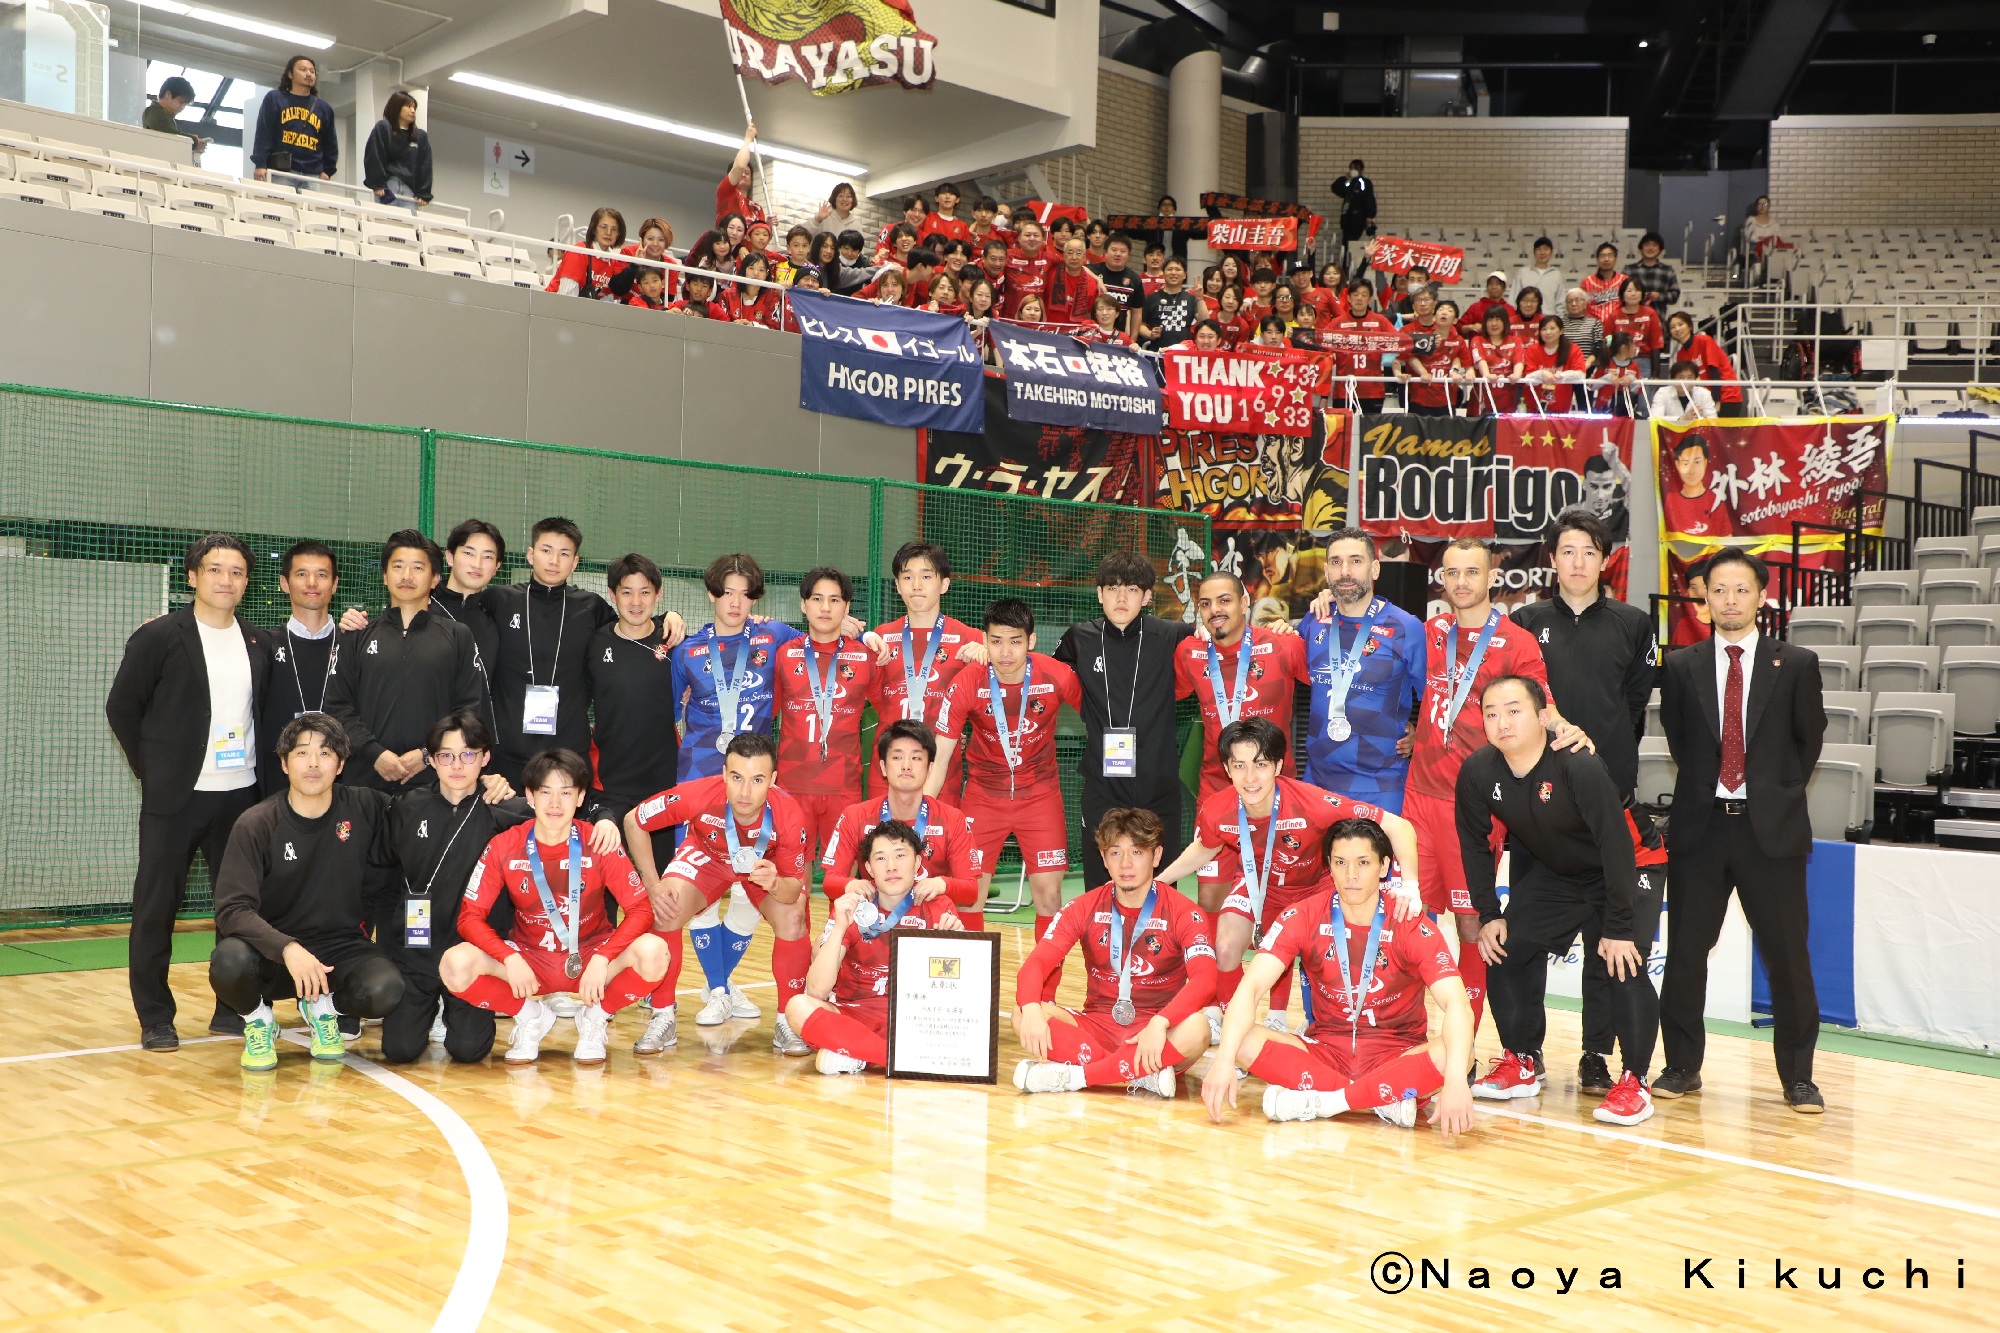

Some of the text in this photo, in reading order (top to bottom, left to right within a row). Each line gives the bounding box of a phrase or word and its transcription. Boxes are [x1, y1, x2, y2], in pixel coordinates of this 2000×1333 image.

[727, 26, 934, 88] URAYASU
[281, 106, 321, 132] CALIFONIA
[1210, 224, 1284, 246] 柴山圭吾
[1375, 243, 1462, 277] 茨木司朗
[800, 315, 975, 363] ピレス イゴール
[1001, 339, 1068, 376] 本石
[1352, 354, 1366, 369] 13
[1173, 355, 1266, 388] THANK
[828, 361, 962, 407] HIGOR PIRES
[1013, 381, 1156, 415] TAKEHIRO MOTOISHI
[1177, 391, 1232, 424] YOU
[1283, 406, 1311, 427] 33
[1364, 423, 1492, 458] Vamos
[1708, 451, 1792, 511] 外林
[1362, 454, 1584, 533] Rodrigo
[1740, 487, 1821, 527] sotobayashi
[1367, 604, 1378, 618] JFA
[743, 626, 751, 639] JFA
[1244, 632, 1252, 647] JFA
[921, 666, 929, 679] JFA
[1331, 657, 1339, 672] JFA
[1463, 666, 1475, 682] JFA
[732, 678, 740, 692] JFA
[1350, 683, 1375, 693] ervice
[1216, 691, 1225, 705] JFA
[1430, 693, 1450, 730] 13
[998, 721, 1007, 735] JFA
[920, 803, 928, 817] JFA
[571, 826, 579, 840] JFA
[527, 839, 536, 855] JFA
[1038, 851, 1054, 860] 車検
[1038, 857, 1066, 866] コバック
[1246, 859, 1254, 874] JFA
[1271, 870, 1286, 887] 7
[1452, 890, 1469, 900] 車検
[545, 899, 556, 914] JFA
[1112, 944, 1120, 960] JFA
[1363, 963, 1372, 980] JFA
[930, 980, 958, 990] 表彰状
[1369, 992, 1402, 1007] Service
